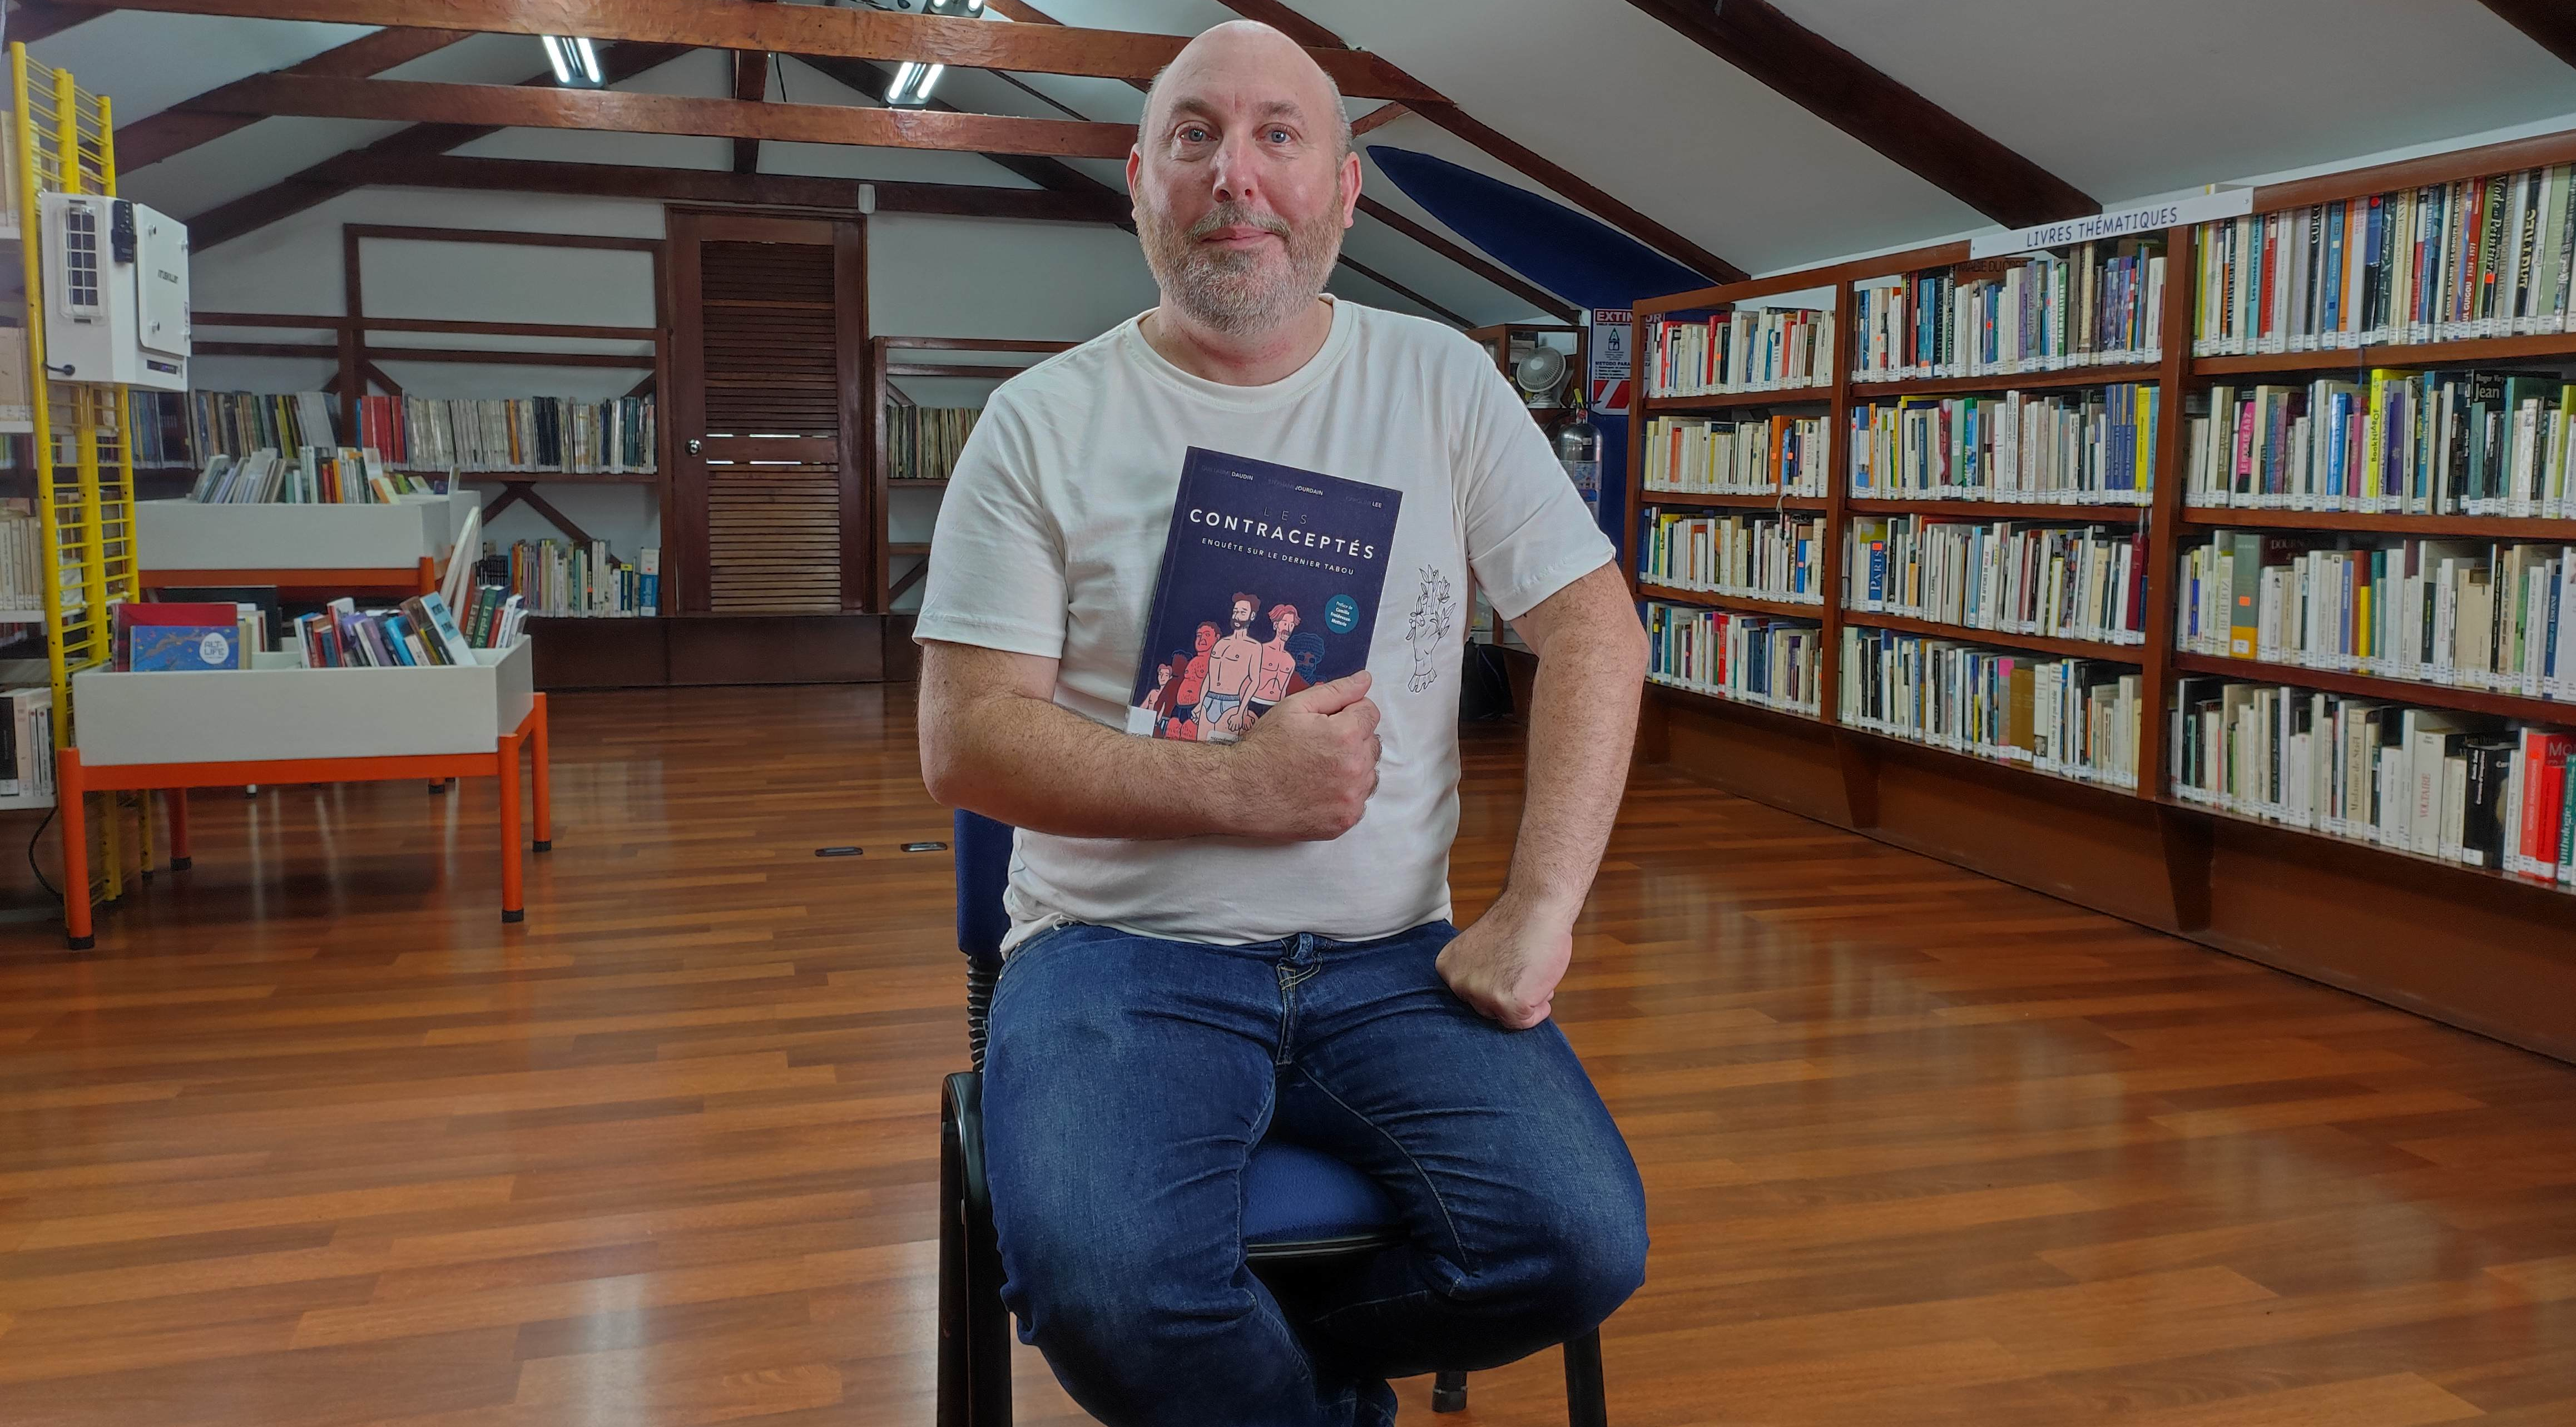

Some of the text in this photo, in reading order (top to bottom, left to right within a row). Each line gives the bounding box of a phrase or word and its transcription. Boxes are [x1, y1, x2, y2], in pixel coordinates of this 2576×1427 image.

[2493, 176, 2506, 208] Mode
[2027, 207, 2178, 247] LIVRES THÉMATIQUES
[2255, 245, 2258, 254] en
[2450, 253, 2455, 261] LE
[2485, 219, 2502, 274] Peinture
[2027, 265, 2035, 310] grossesse
[2464, 281, 2472, 310] GUIGOU
[2474, 383, 2500, 402] Jean
[2243, 432, 2250, 441] DE
[1231, 472, 1254, 480] DAUDIN
[2241, 463, 2248, 472] LE
[1295, 485, 1324, 496] JOURDAIN
[1264, 506, 1307, 524] LES
[1190, 508, 1374, 559] CONTRACEPTÉS
[1202, 537, 1243, 552] ENQUÊTE
[1247, 547, 1264, 557] SUR
[1282, 554, 1320, 568] DERNIER
[1324, 563, 1354, 575] TABOU
[1870, 551, 1881, 591] PARIS
[2220, 580, 2231, 631] BERLIOZ
[2352, 761, 2360, 772] de
[2351, 774, 2360, 810] Madame
[2420, 772, 2431, 817] VOLTAIRE
